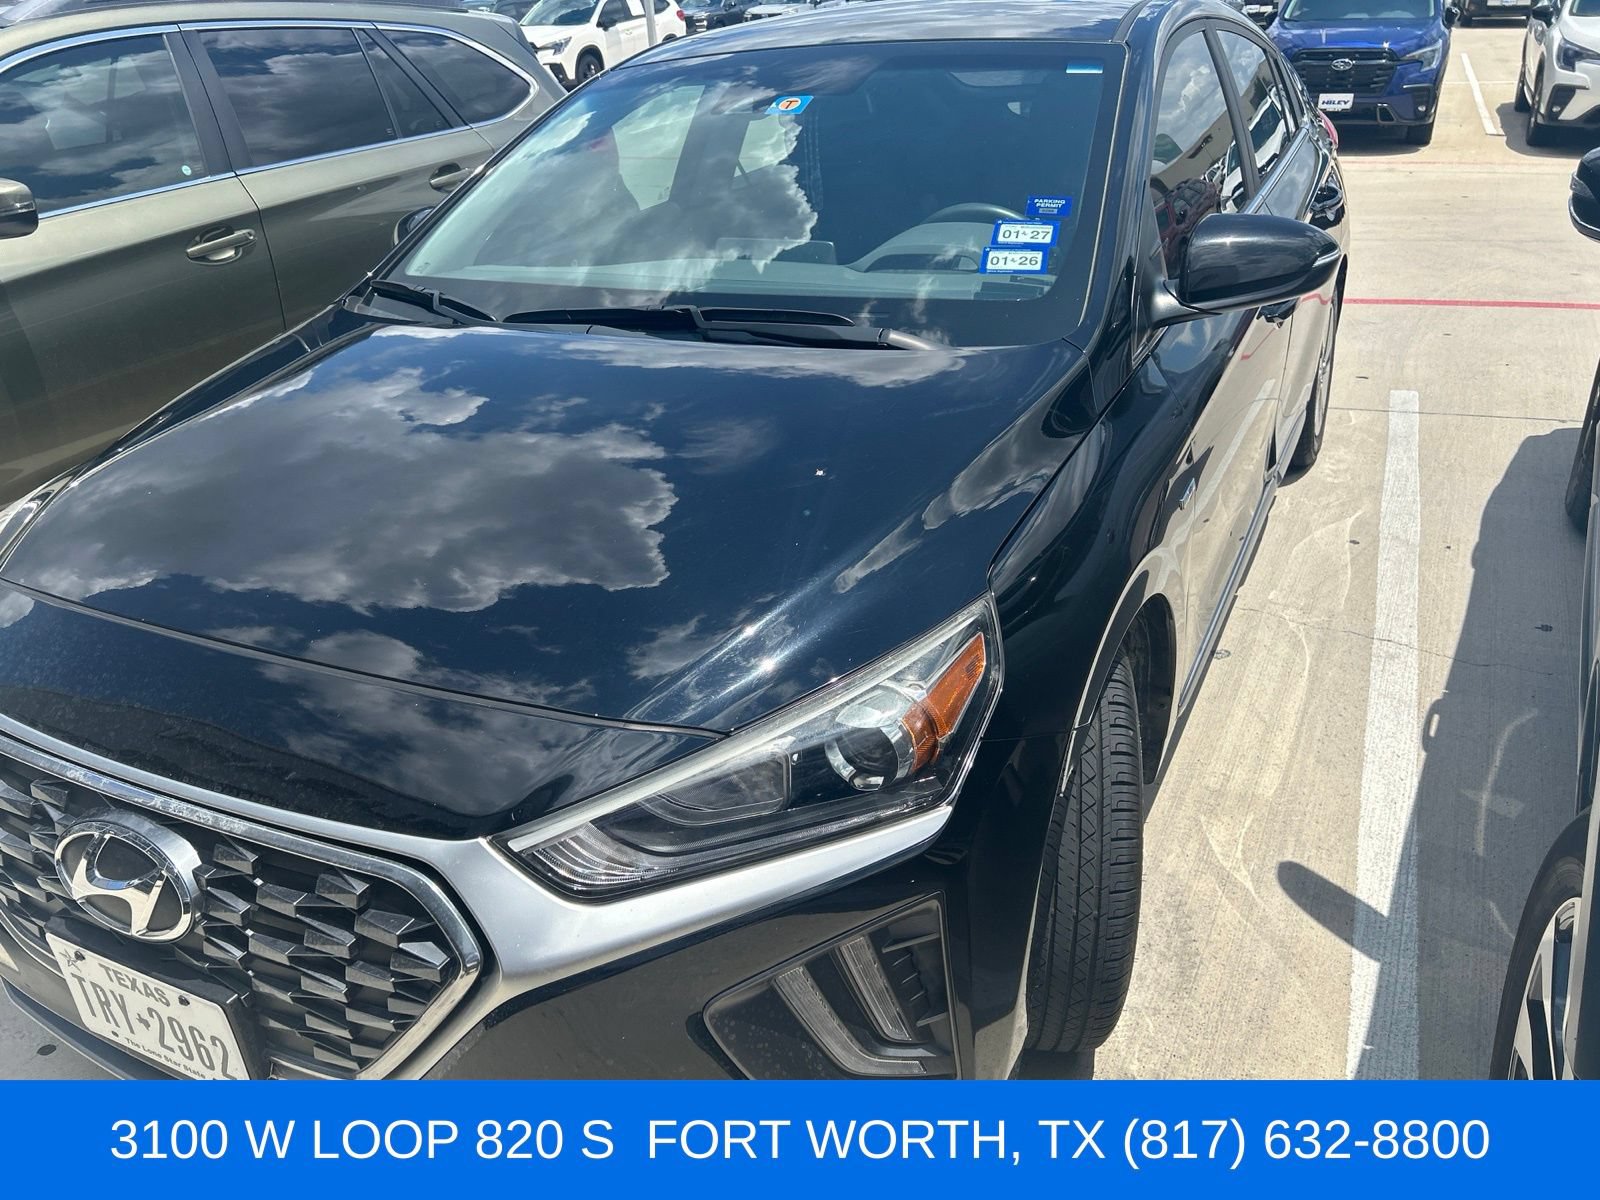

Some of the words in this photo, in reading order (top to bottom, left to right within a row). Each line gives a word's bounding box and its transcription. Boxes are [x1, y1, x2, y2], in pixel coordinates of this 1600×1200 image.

[98, 962, 171, 1008] TEXAS
[125, 1037, 141, 1049] The
[141, 1045, 162, 1058] Lone
[163, 1055, 181, 1067] Star
[183, 1064, 206, 1079] State
